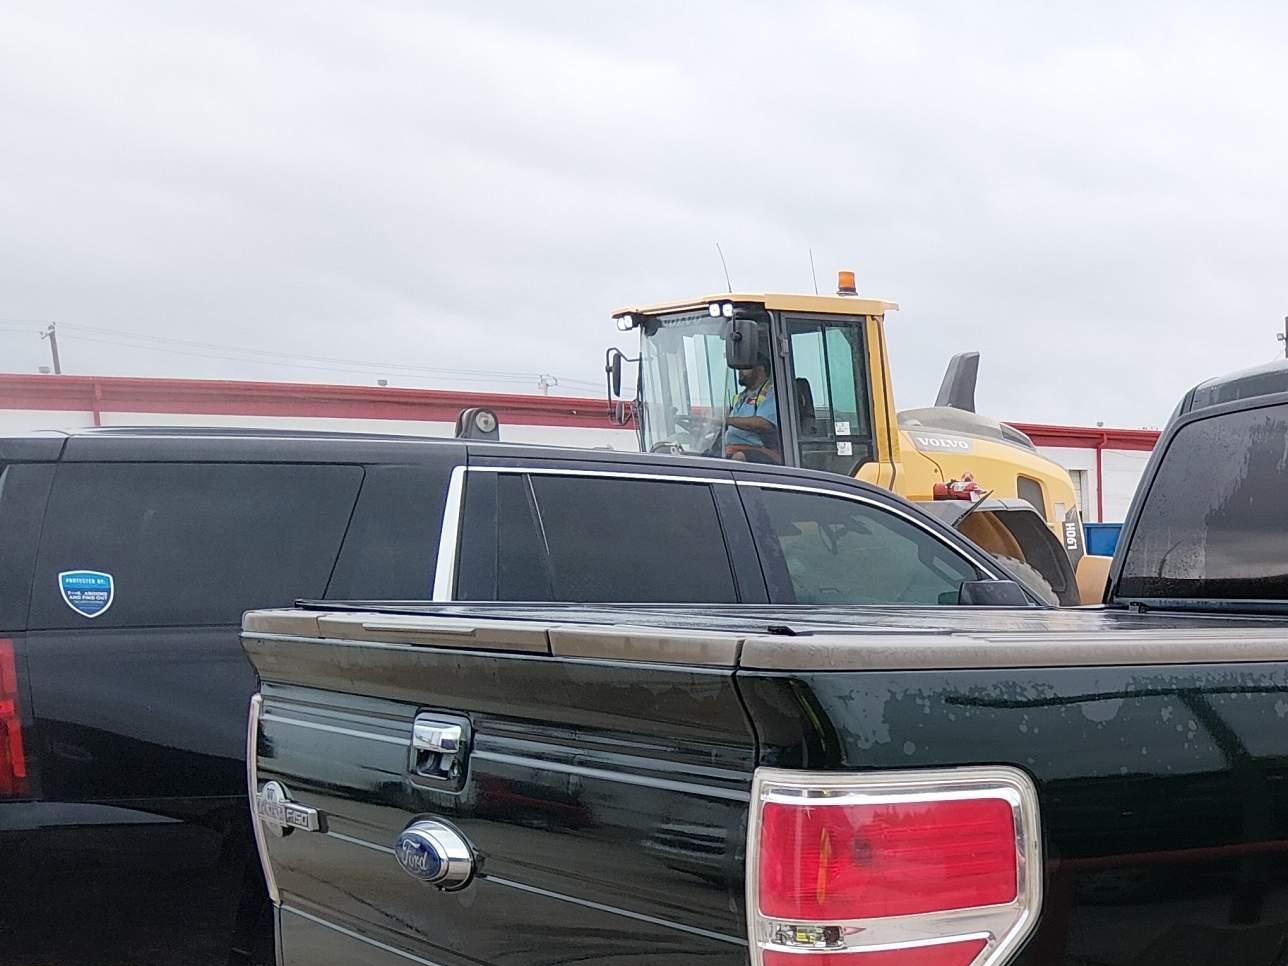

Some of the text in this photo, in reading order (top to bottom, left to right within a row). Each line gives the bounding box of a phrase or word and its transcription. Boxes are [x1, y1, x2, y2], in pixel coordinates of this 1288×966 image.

[917, 437, 969, 449] VOLVO
[1065, 522, 1078, 550] L90H
[402, 839, 428, 872] Ford
